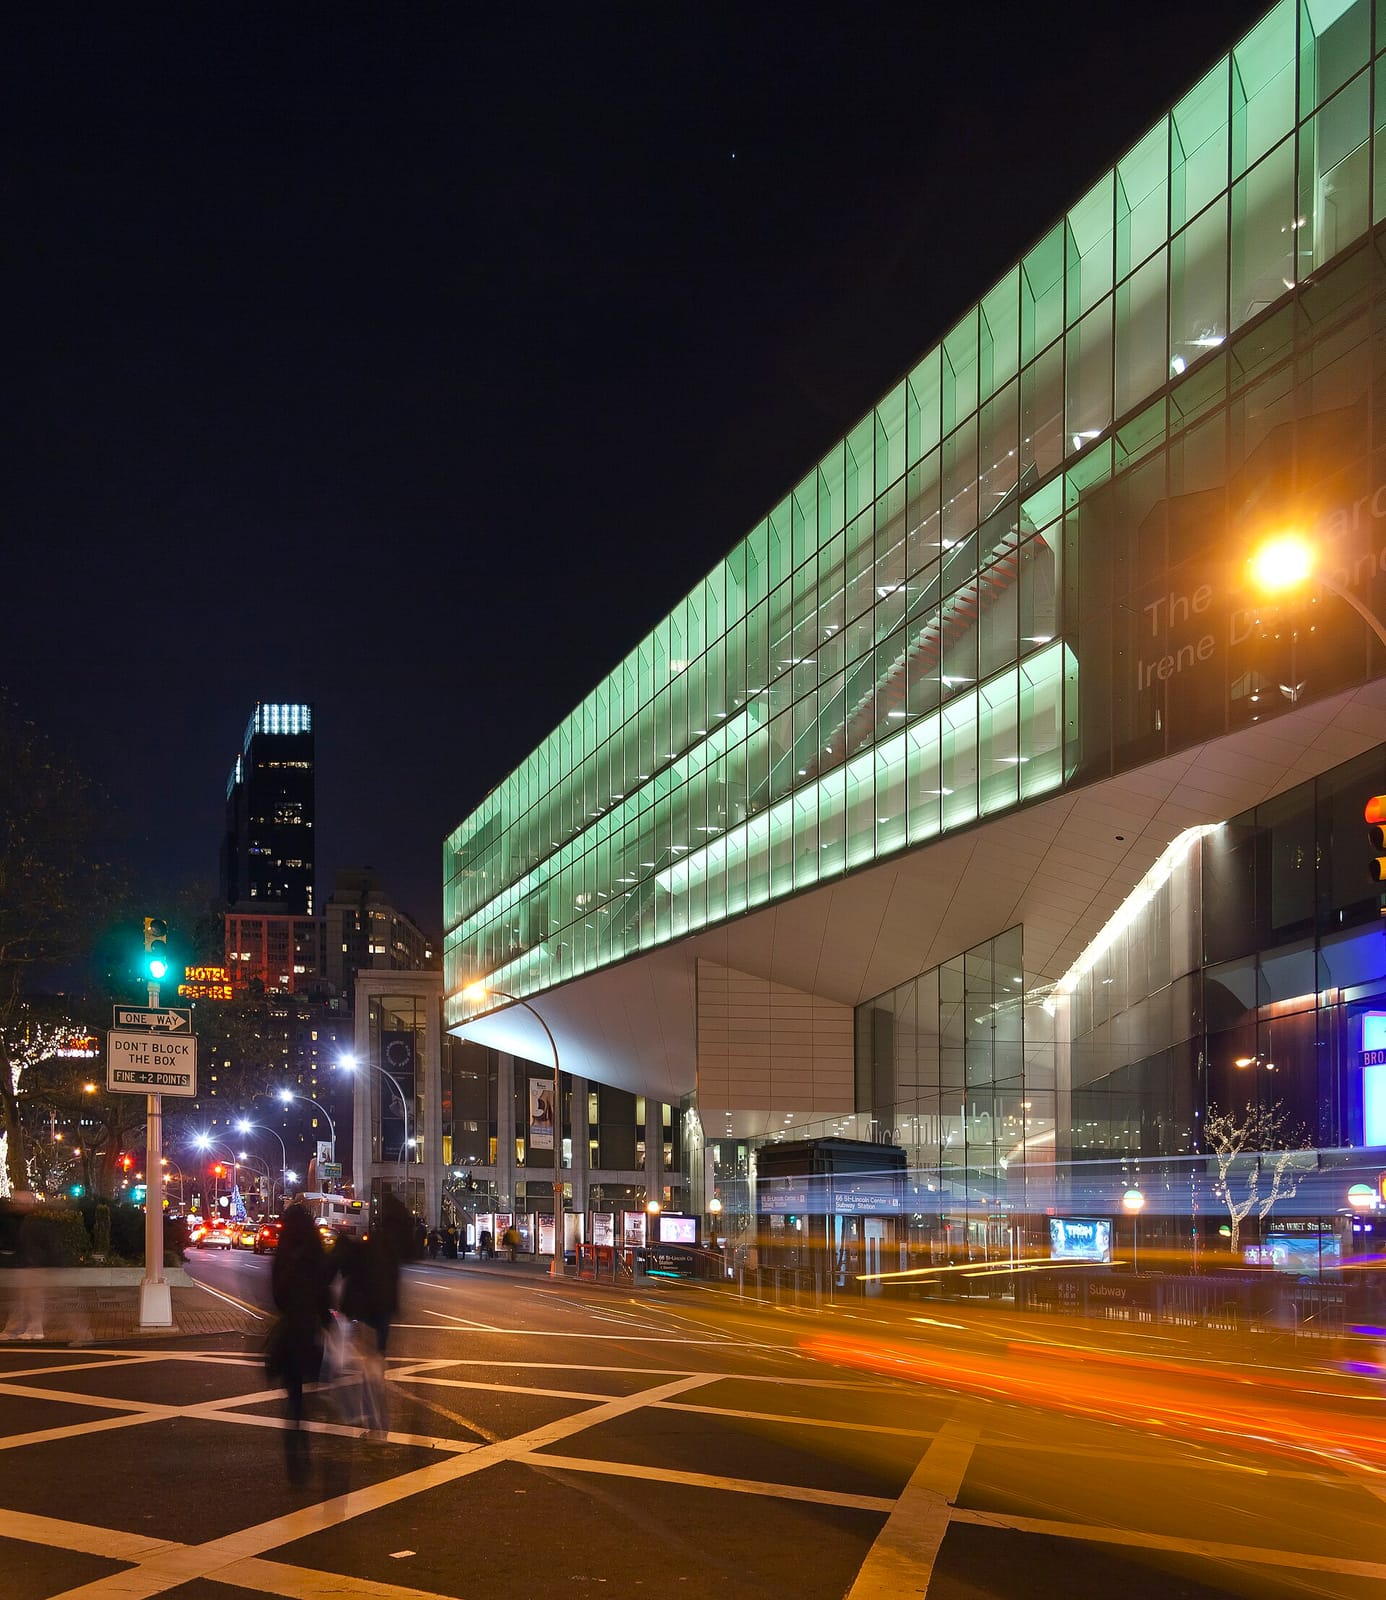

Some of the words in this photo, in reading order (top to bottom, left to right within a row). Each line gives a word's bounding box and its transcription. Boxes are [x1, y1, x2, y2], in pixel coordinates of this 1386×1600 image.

[1144, 583, 1213, 637] The
[1138, 634, 1216, 691] Irene
[185, 966, 229, 982] HOTEL
[125, 1013, 147, 1024] ONE
[156, 1015, 179, 1026] WAY
[115, 1040, 148, 1052] DON'T
[152, 1043, 189, 1055] BLOCK
[129, 1053, 150, 1064] THE
[154, 1055, 176, 1066] BOX
[1364, 1050, 1386, 1066] BRO
[116, 1071, 136, 1082] FINE
[139, 1073, 154, 1083] +2
[156, 1074, 187, 1085] POINTS
[864, 1121, 902, 1146] Alice
[907, 1113, 953, 1151] Tully
[960, 1097, 1003, 1144] Hall
[1089, 1283, 1127, 1299] Subway
